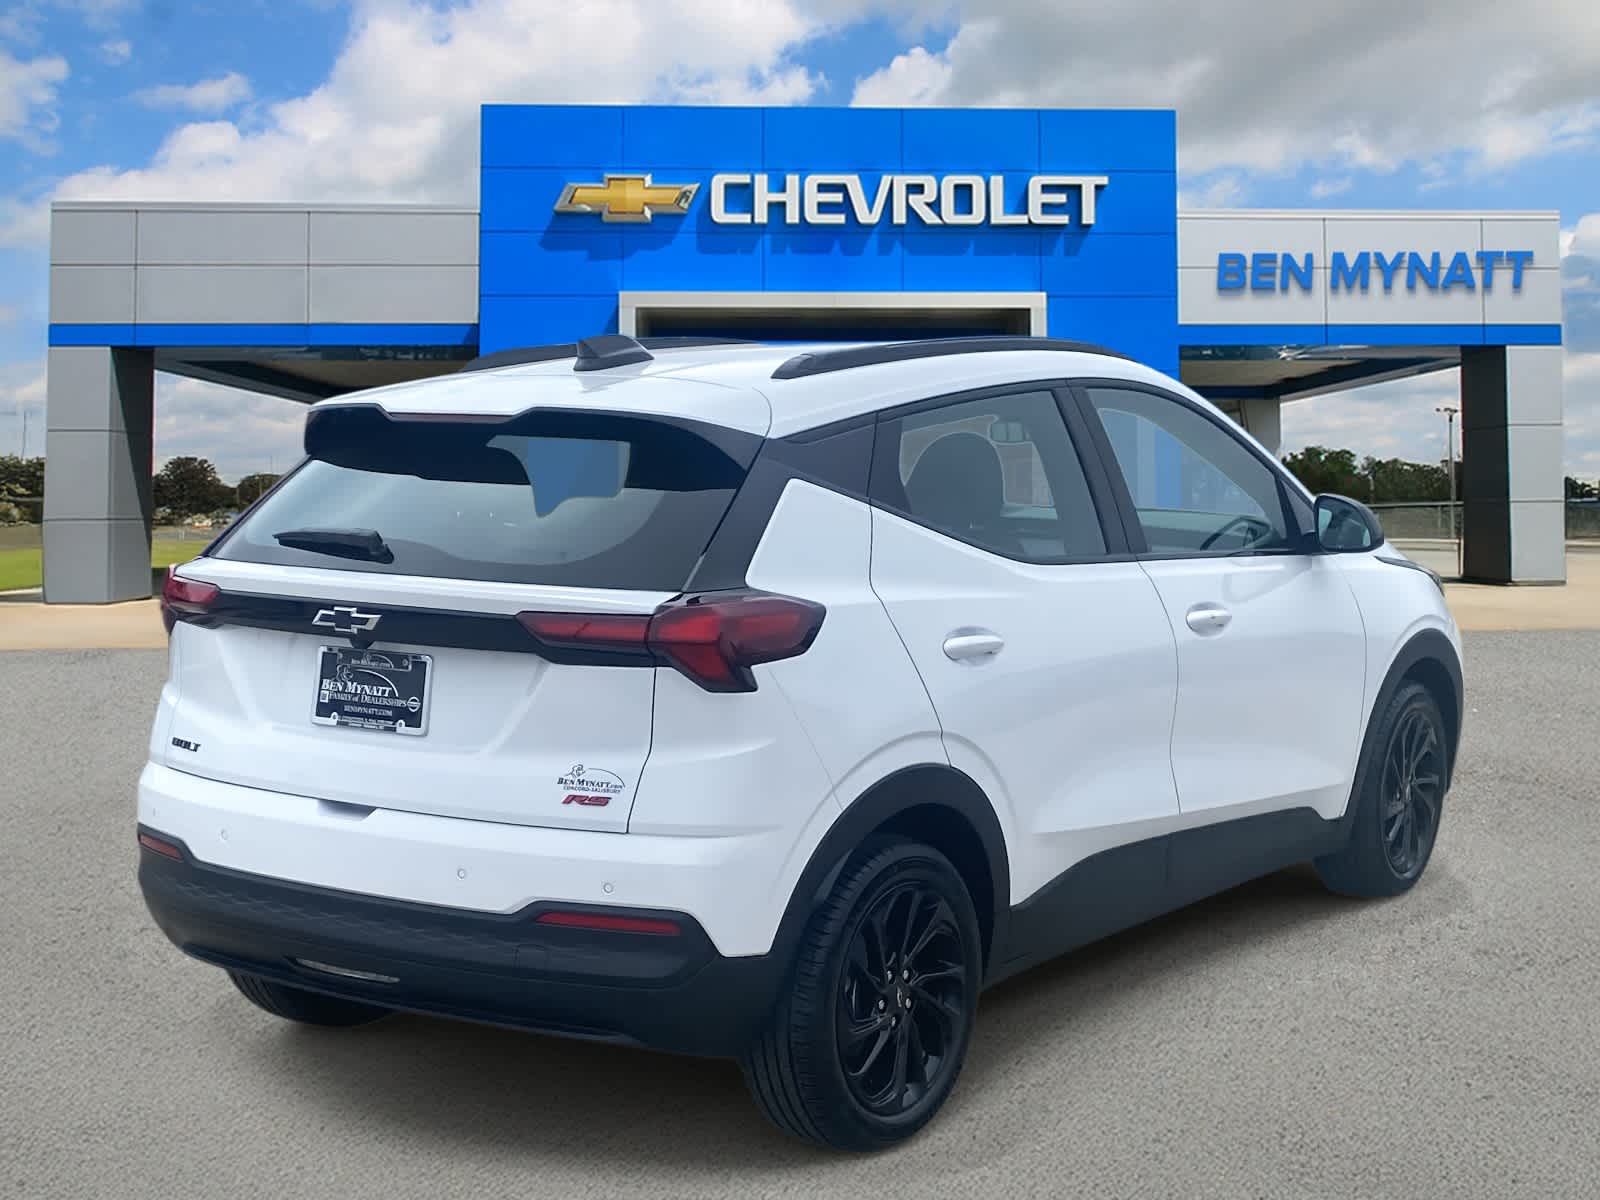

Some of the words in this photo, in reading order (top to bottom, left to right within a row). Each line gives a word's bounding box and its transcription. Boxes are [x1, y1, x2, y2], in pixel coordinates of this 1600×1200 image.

[710, 173, 1109, 225] CHEVROLET
[1217, 252, 1313, 290] BEN
[1330, 250, 1534, 290] MYNATT
[322, 679, 344, 691] BEN
[345, 681, 392, 697] MYNATT
[361, 695, 406, 707] DEALERSHIPS
[172, 736, 201, 752] BOLT
[557, 777, 575, 785] BEN
[562, 794, 612, 806] RS
